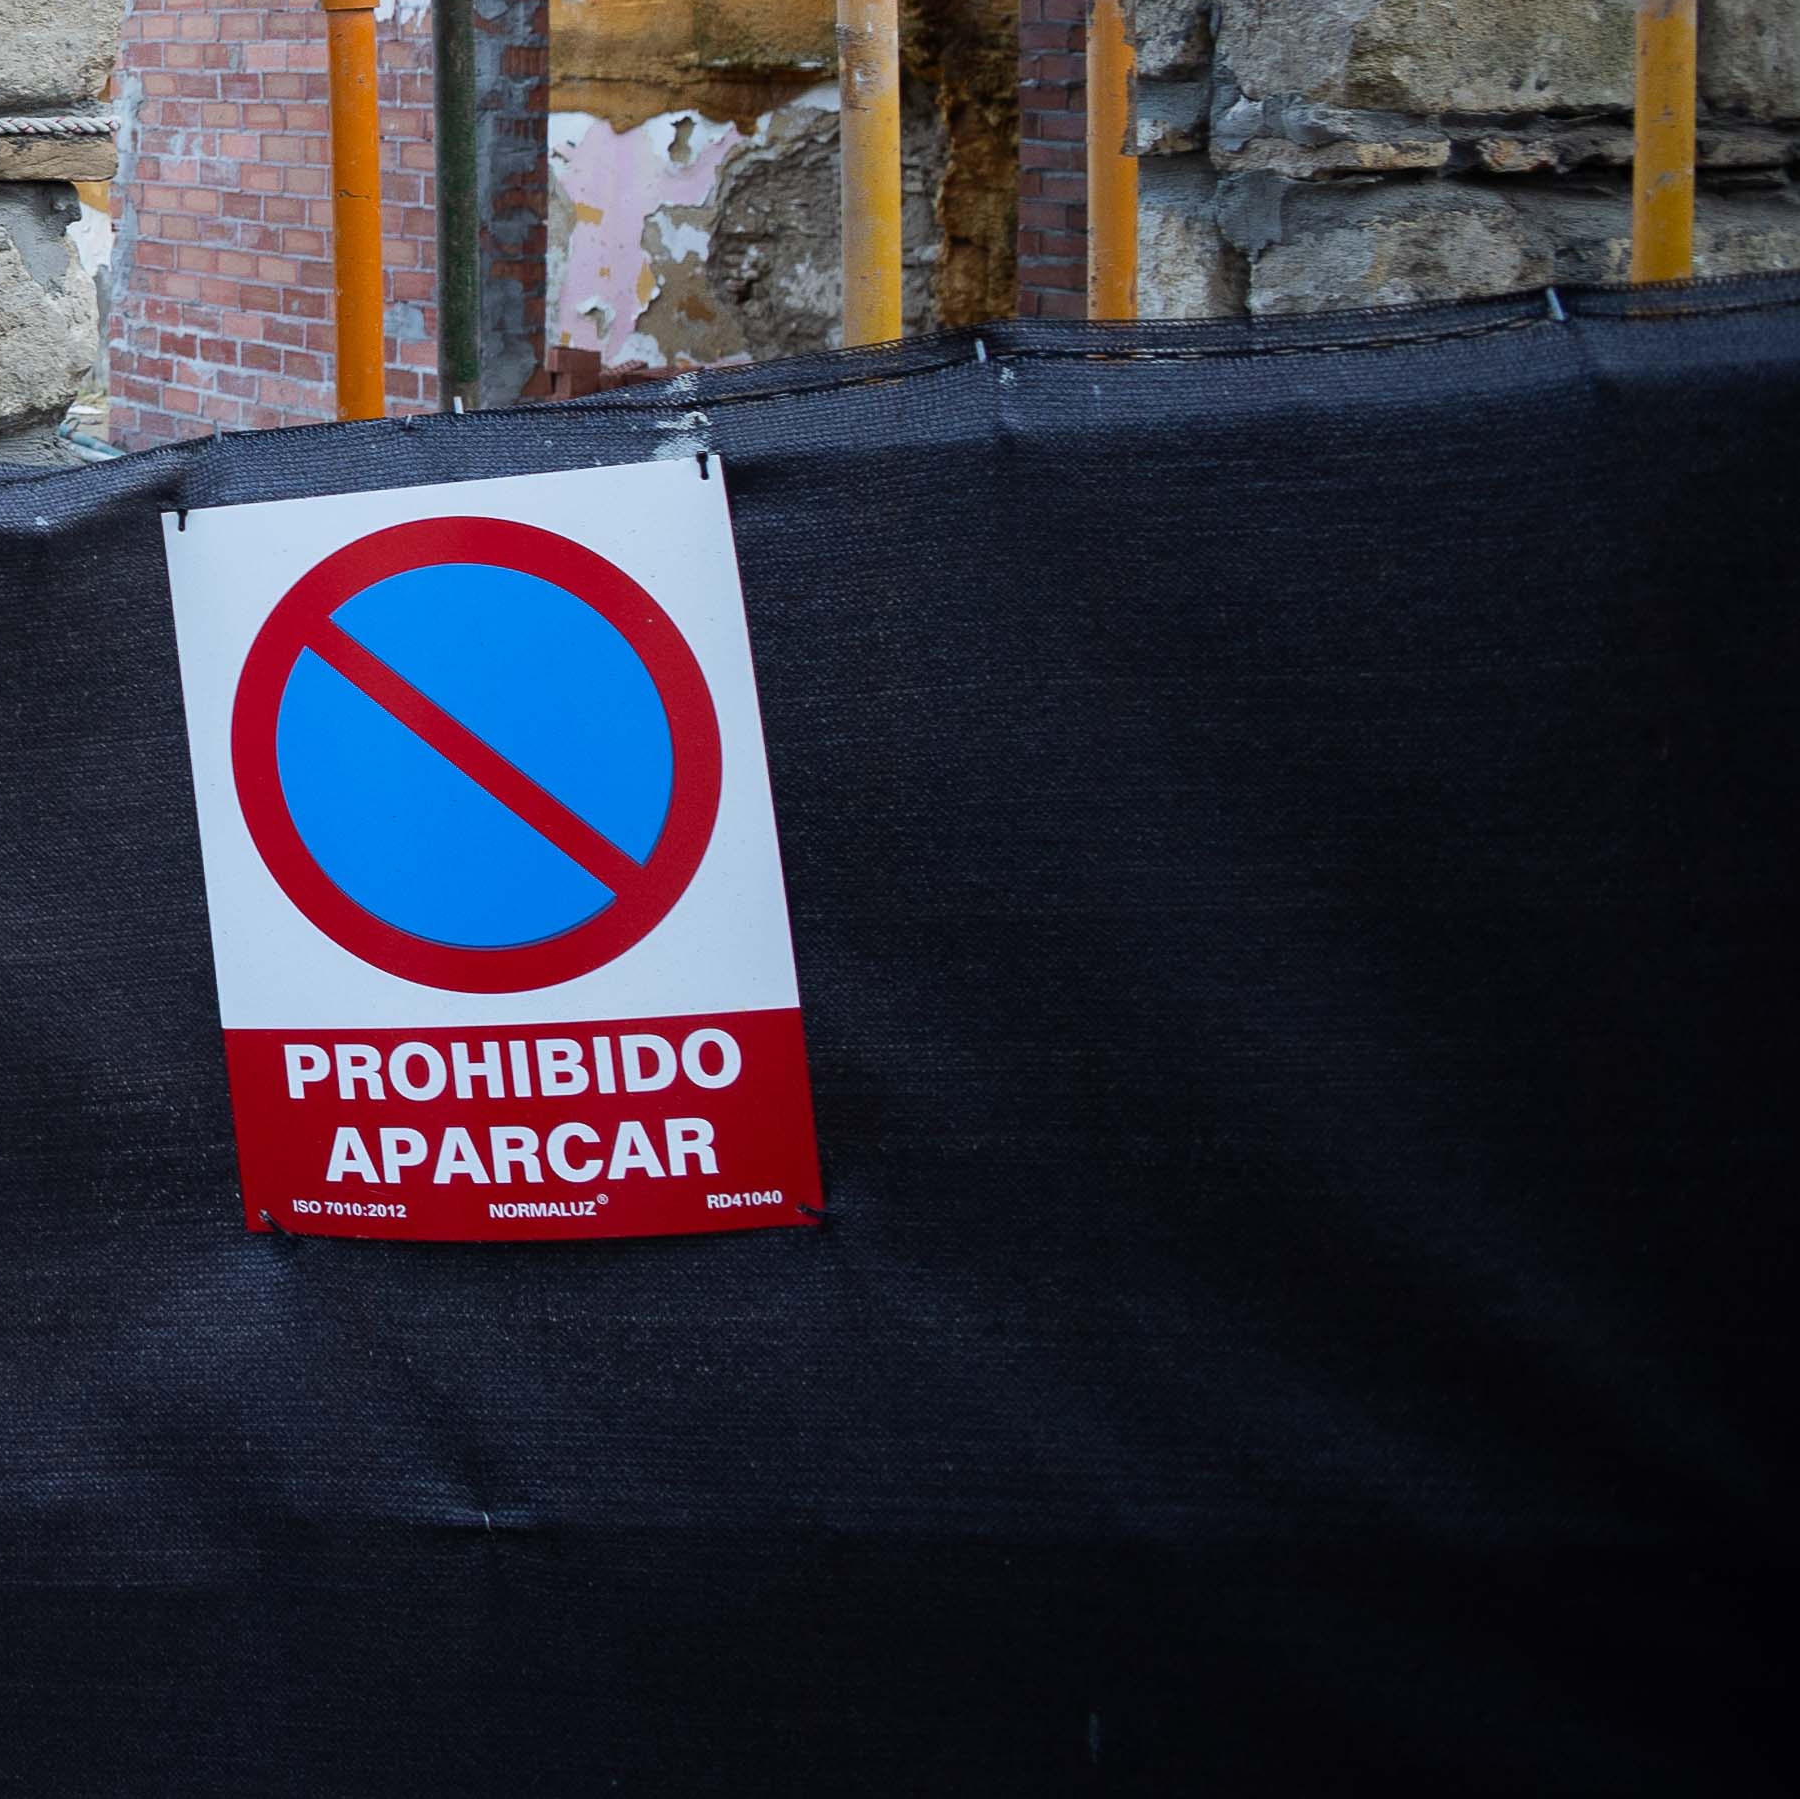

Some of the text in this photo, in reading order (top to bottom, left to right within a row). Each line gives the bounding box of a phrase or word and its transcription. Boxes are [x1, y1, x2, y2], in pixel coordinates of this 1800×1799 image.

[283, 1027, 743, 1101] PROHIBIDO
[325, 1116, 720, 1184] APARCAR
[292, 1199, 407, 1218] ISO 7010:2012
[706, 1189, 783, 1210] RD41040
